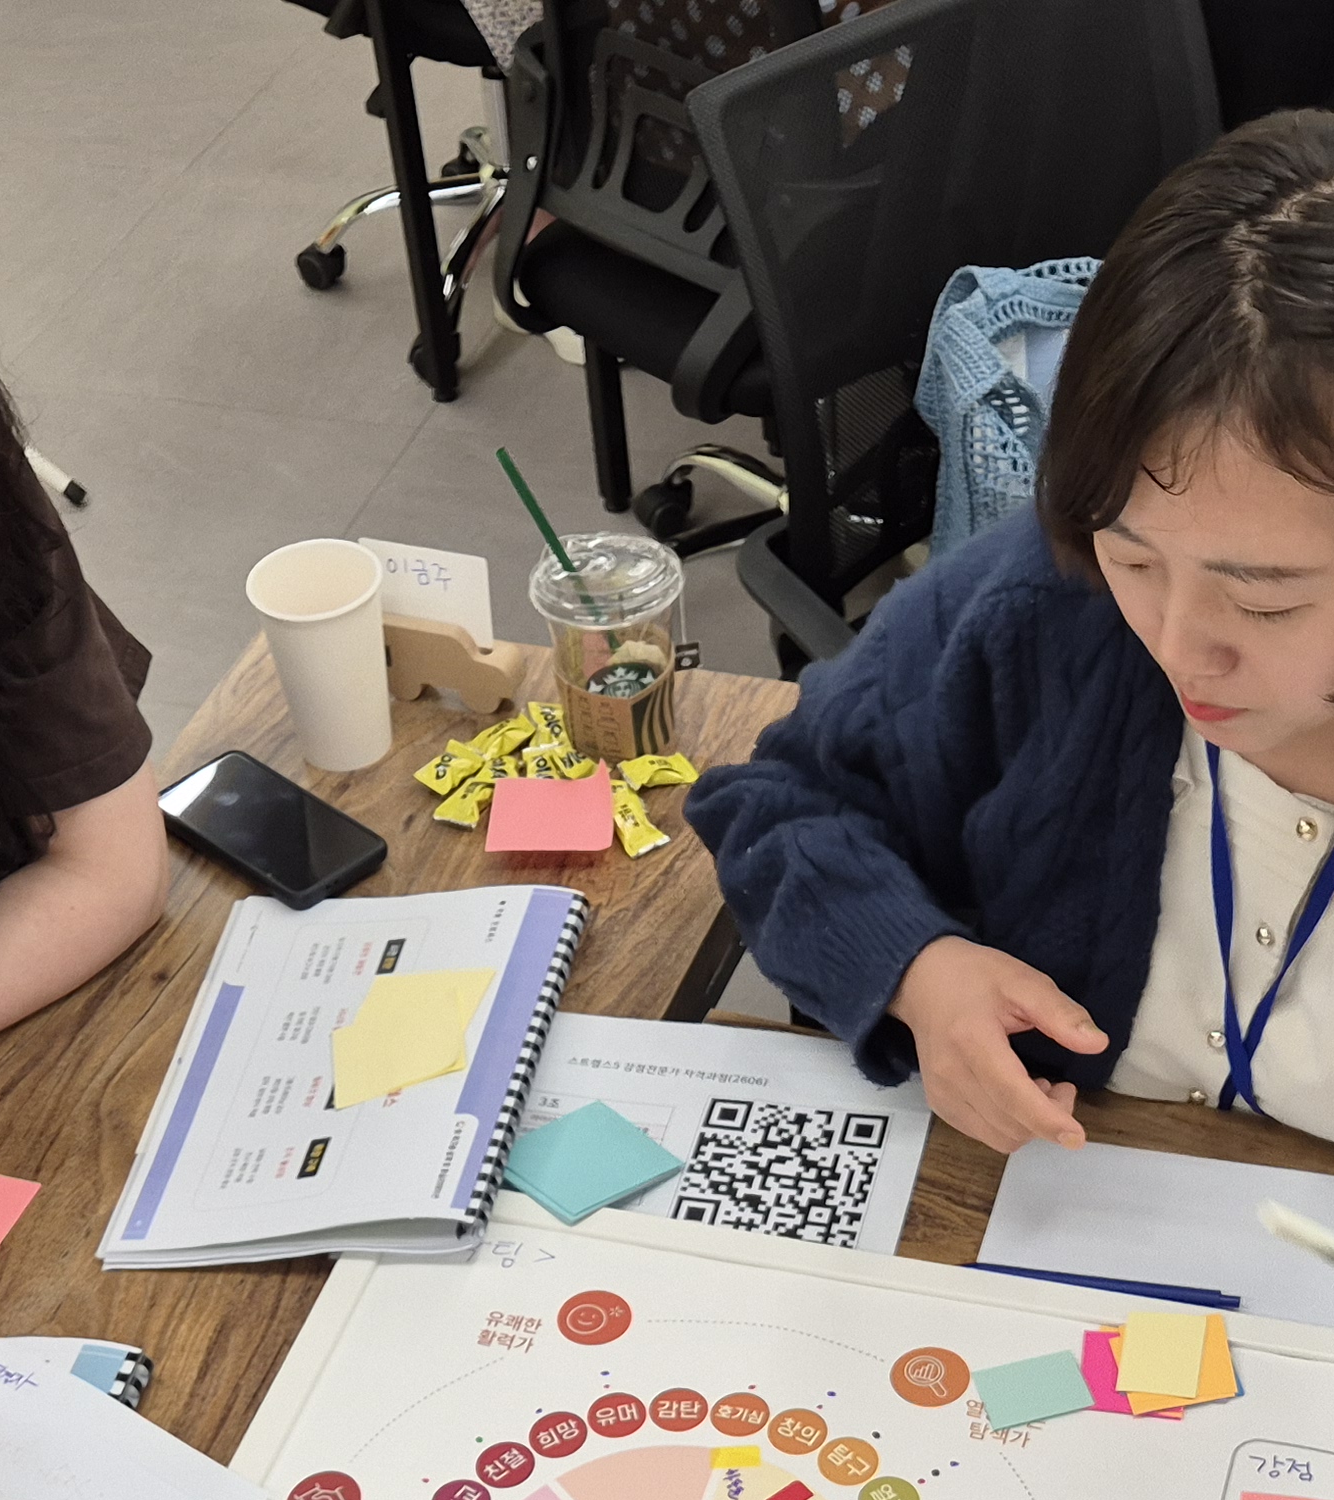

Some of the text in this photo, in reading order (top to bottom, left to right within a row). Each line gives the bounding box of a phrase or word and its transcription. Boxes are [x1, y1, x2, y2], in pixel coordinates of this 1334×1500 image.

[485, 1311, 542, 1334] 유쾌한
[477, 1328, 534, 1353] 활력가
[595, 1402, 639, 1427] 유머
[657, 1401, 701, 1419] 감탄
[715, 1404, 765, 1425] 호기심
[536, 1419, 579, 1449] 희망
[776, 1416, 821, 1447] 창의
[483, 1448, 528, 1481] 친절
[826, 1444, 871, 1477] 탐구
[1248, 1455, 1314, 1482] 강점
